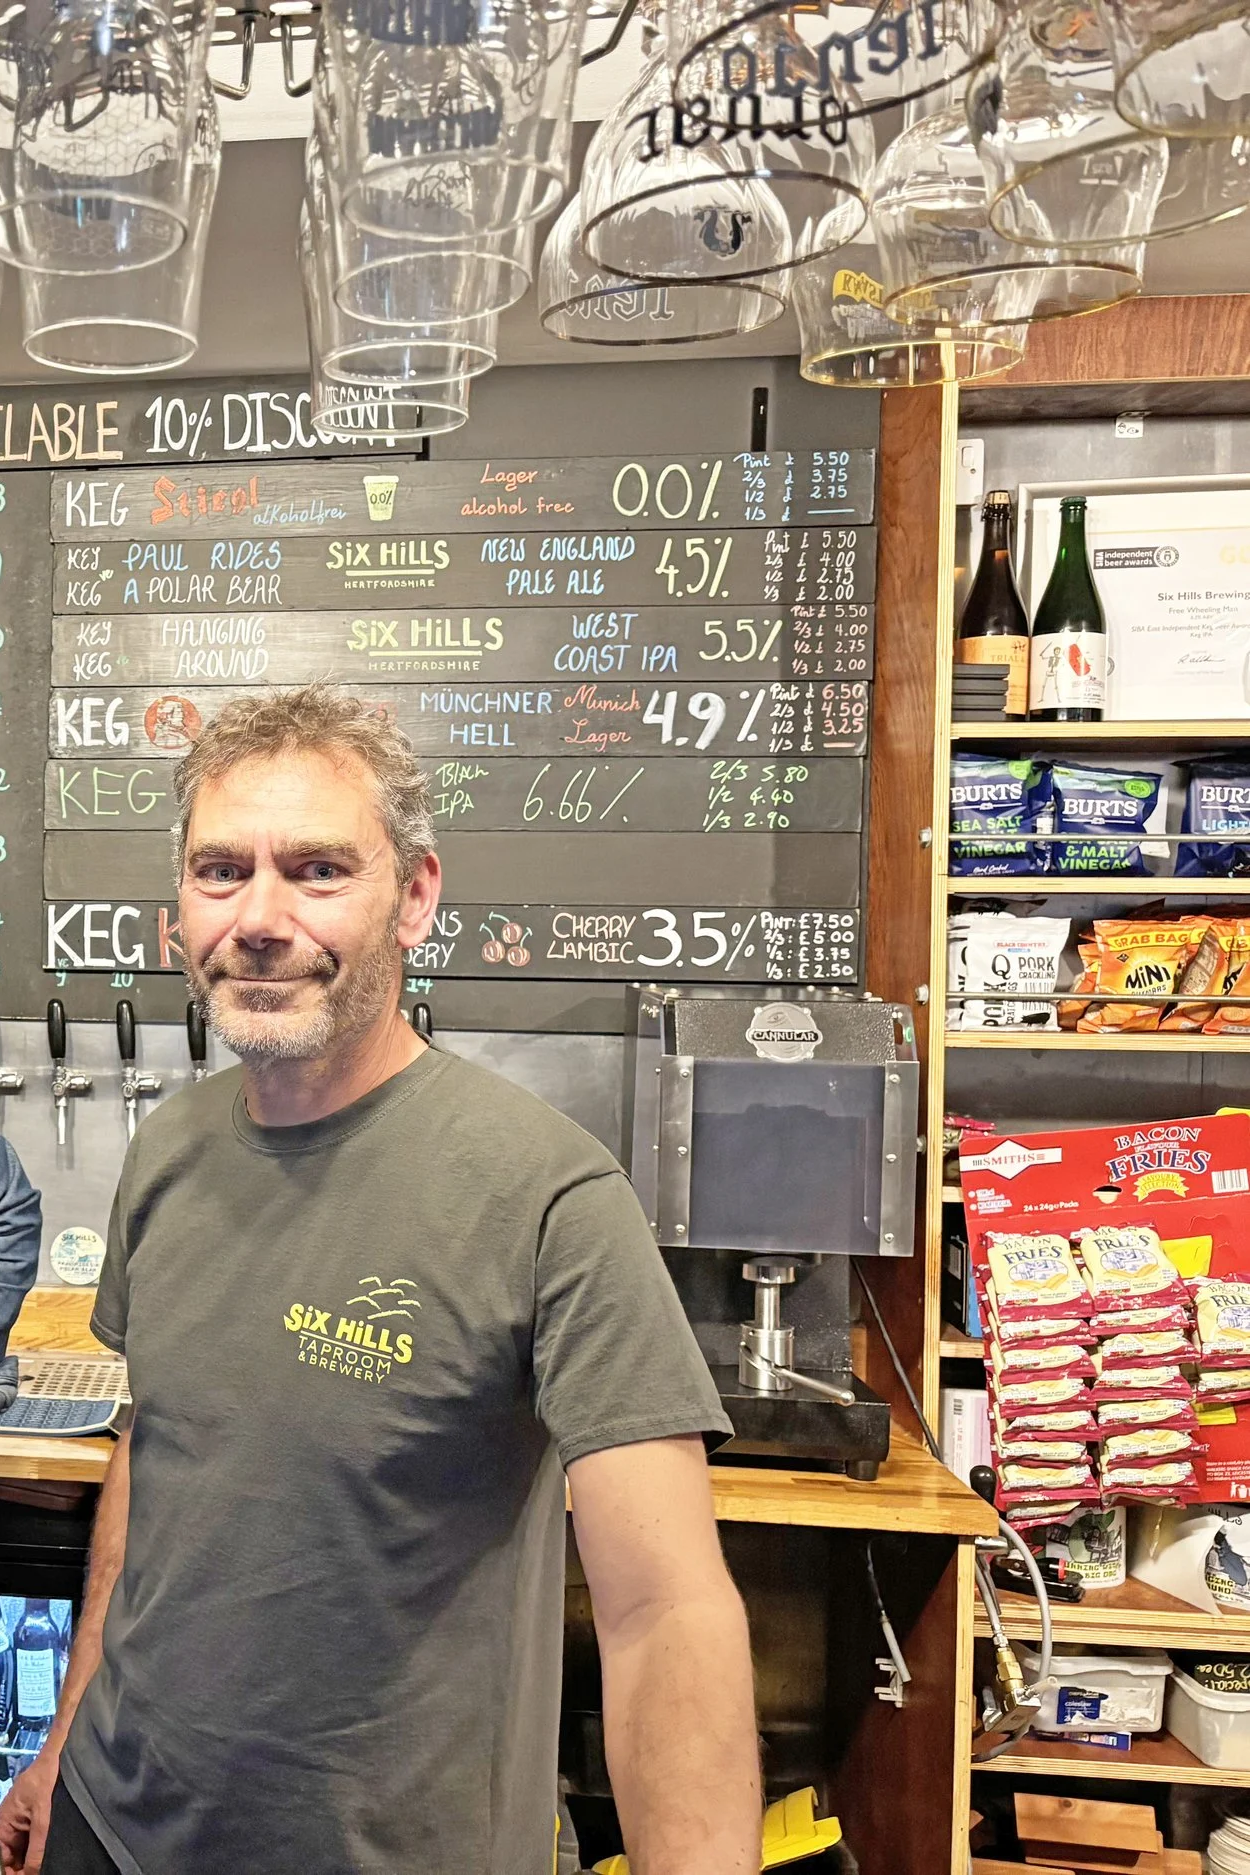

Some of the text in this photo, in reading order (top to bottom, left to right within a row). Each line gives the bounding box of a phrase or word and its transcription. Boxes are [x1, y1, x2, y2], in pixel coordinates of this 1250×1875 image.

[145, 395, 213, 457] 10%
[480, 463, 538, 492] Lager
[65, 481, 129, 527] KEG
[461, 497, 527, 517] alcohol
[122, 541, 283, 571] PAUL RIDES
[481, 535, 635, 563] NEW ENGLAND
[1104, 550, 1153, 559] independent
[1104, 557, 1153, 567] beer awards
[124, 574, 283, 605] A POLAR BEAR
[344, 578, 436, 589] HERTFORDSHIRE
[506, 568, 605, 596] PALE ALE
[1158, 590, 1250, 601] Six Hills Brewing
[162, 617, 265, 647] HANGING
[572, 613, 638, 640] WEST
[175, 647, 269, 679] AROUND
[554, 644, 678, 674] COAST IPA
[420, 687, 552, 714] MÜNCHNER
[565, 684, 640, 712] Munich
[56, 697, 129, 747] KEG
[450, 723, 515, 746] HELL
[565, 719, 631, 752] Lager
[58, 767, 167, 818] KEG
[433, 791, 475, 818] IPA
[951, 782, 1023, 803] BURTS
[1062, 798, 1138, 817] BURTS
[953, 815, 1024, 833] SEA SALT
[954, 841, 1027, 859] VINEGAR
[1082, 845, 1127, 859] MALT
[47, 904, 144, 968] KEG
[552, 913, 636, 939] CHERRY
[546, 942, 634, 964] LAMBIC
[1114, 932, 1188, 948] GRAB BAG
[1018, 956, 1055, 972] PORK
[1018, 971, 1055, 980] CRACKLING
[753, 1030, 817, 1042] CANNULAR
[1114, 1126, 1202, 1151] BACON
[983, 1152, 1035, 1166] SMITHS
[1106, 1149, 1211, 1182] FRIES
[299, 1335, 392, 1375] TAPROOM
[309, 1353, 386, 1384] BREWERY
